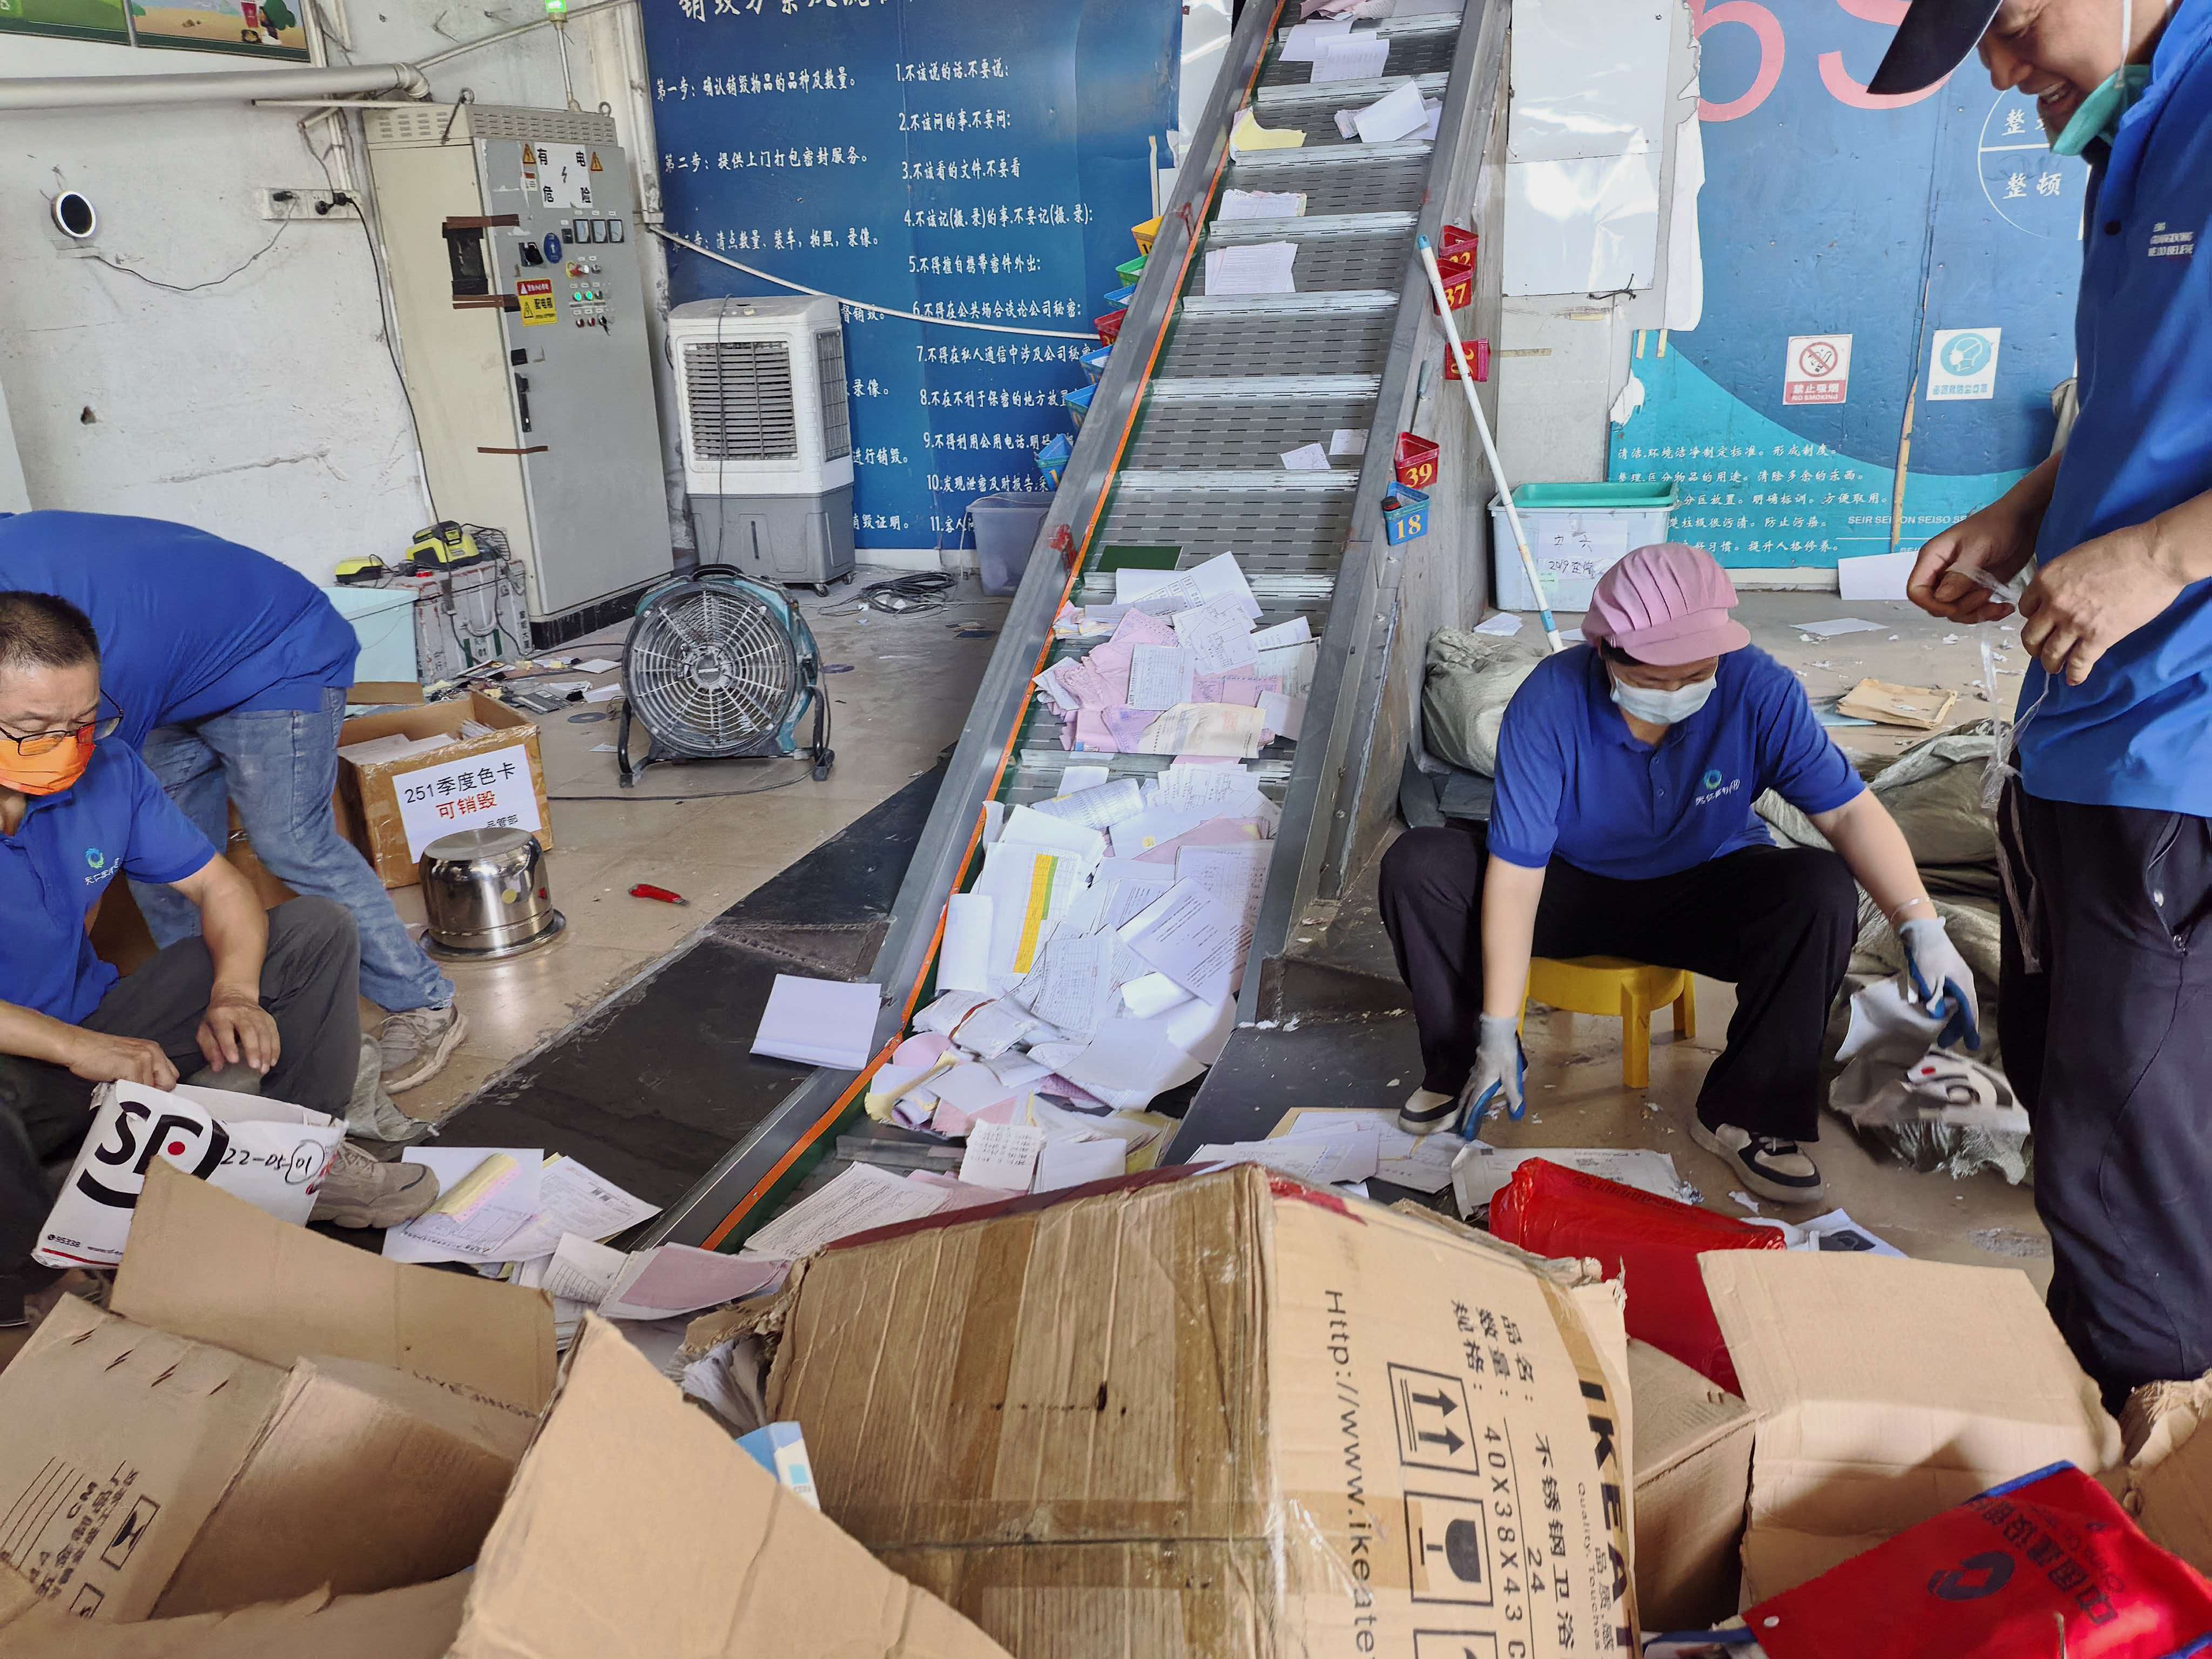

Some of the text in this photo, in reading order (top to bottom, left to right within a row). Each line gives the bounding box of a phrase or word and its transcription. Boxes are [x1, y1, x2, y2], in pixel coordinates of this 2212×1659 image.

[2002, 172, 2062, 199] 整顿
[1444, 282, 1467, 308] 37
[846, 378, 889, 398] 录像。
[1405, 463, 1433, 488] 39
[1395, 514, 1421, 540] 18
[1874, 515, 1916, 524] SEION
[404, 762, 516, 804] 251季度色卡
[436, 790, 498, 819] 可销毁
[1325, 1290, 1378, 1659] Http://www.ikeate
[1527, 1548, 1546, 1595] 24
